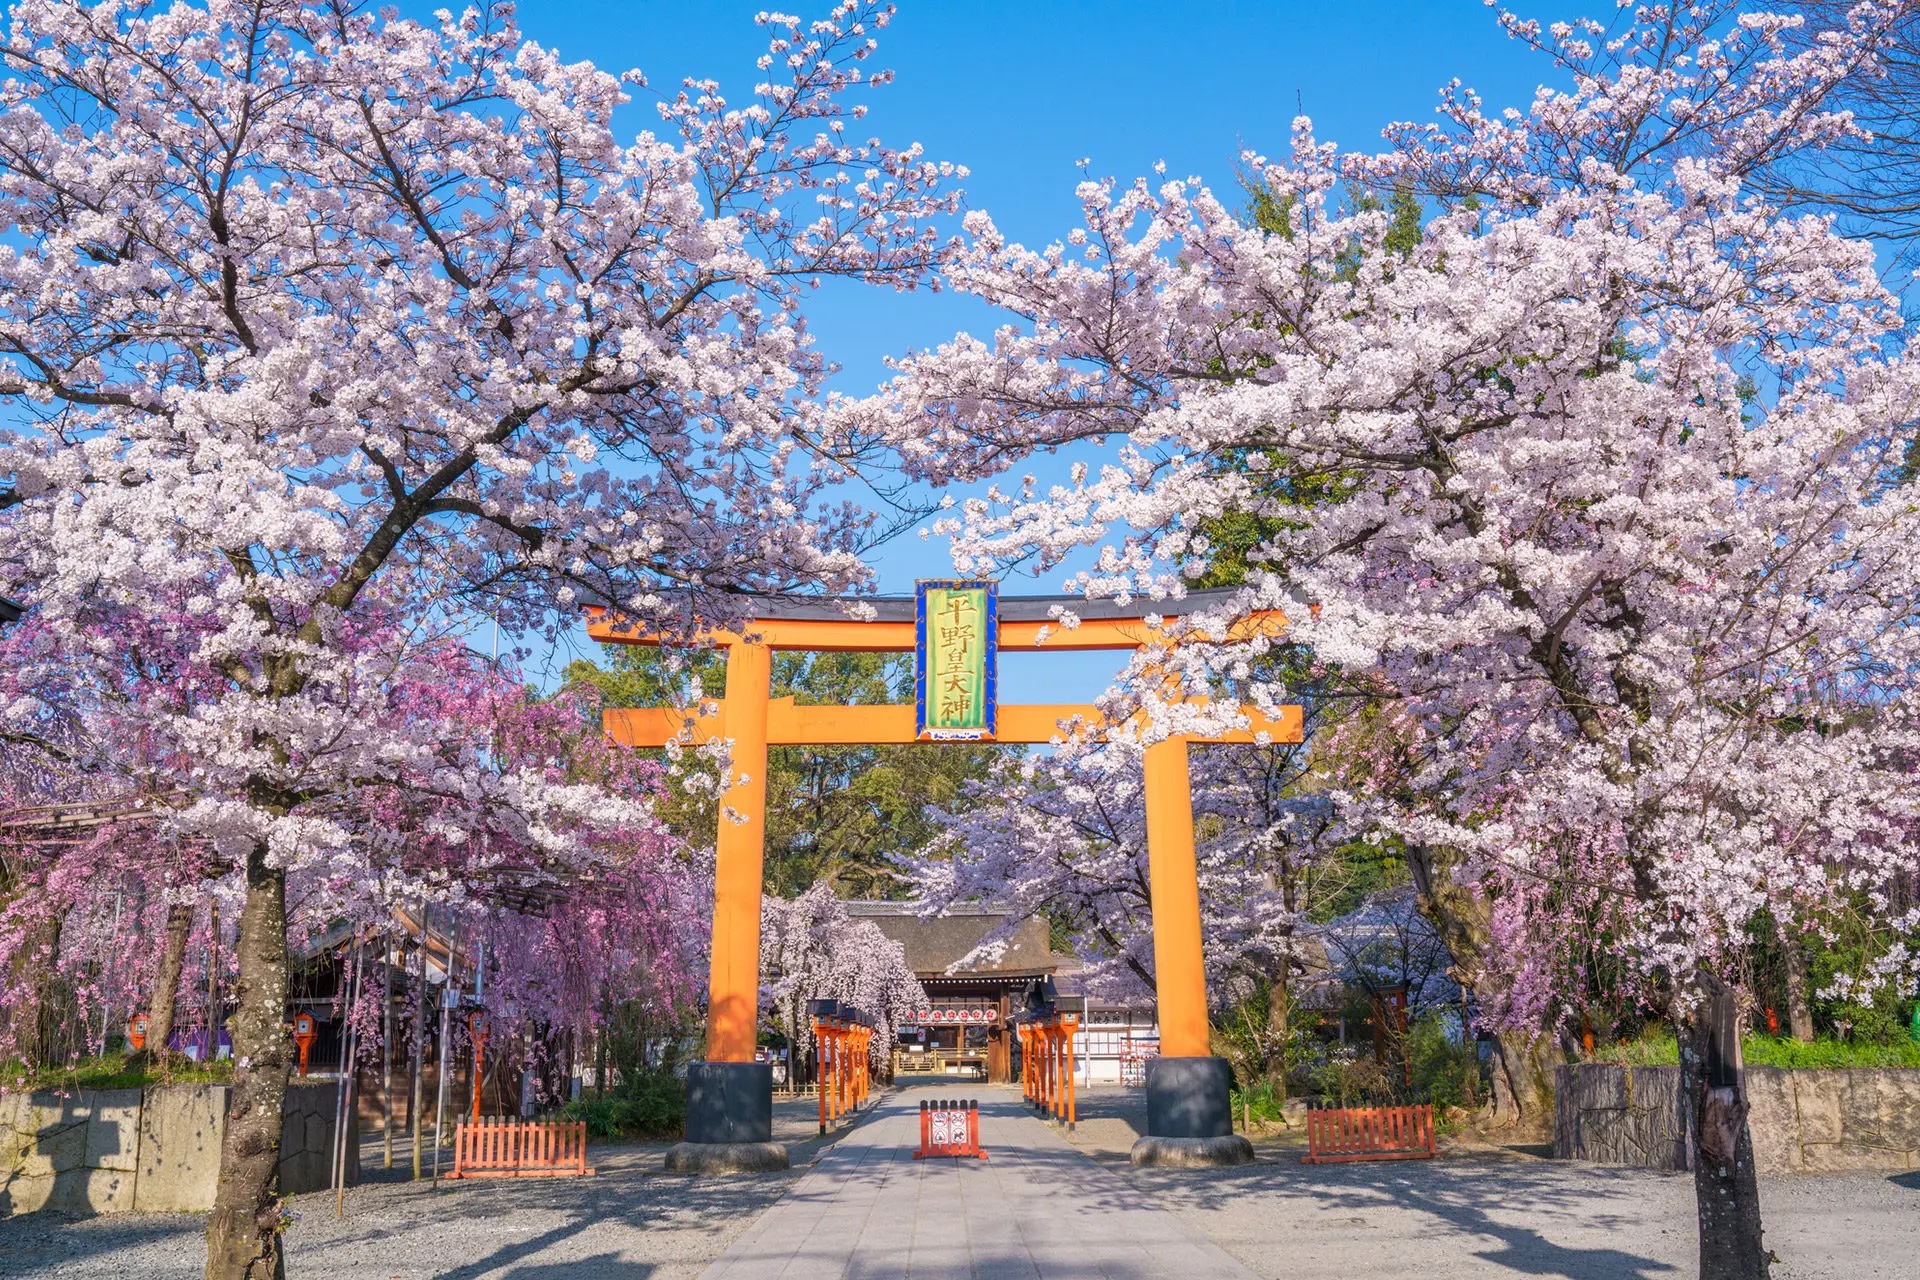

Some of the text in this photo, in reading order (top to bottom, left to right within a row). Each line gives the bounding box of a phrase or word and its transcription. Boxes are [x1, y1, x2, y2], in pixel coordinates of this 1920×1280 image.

[937, 593, 977, 722] 平野皇大神
